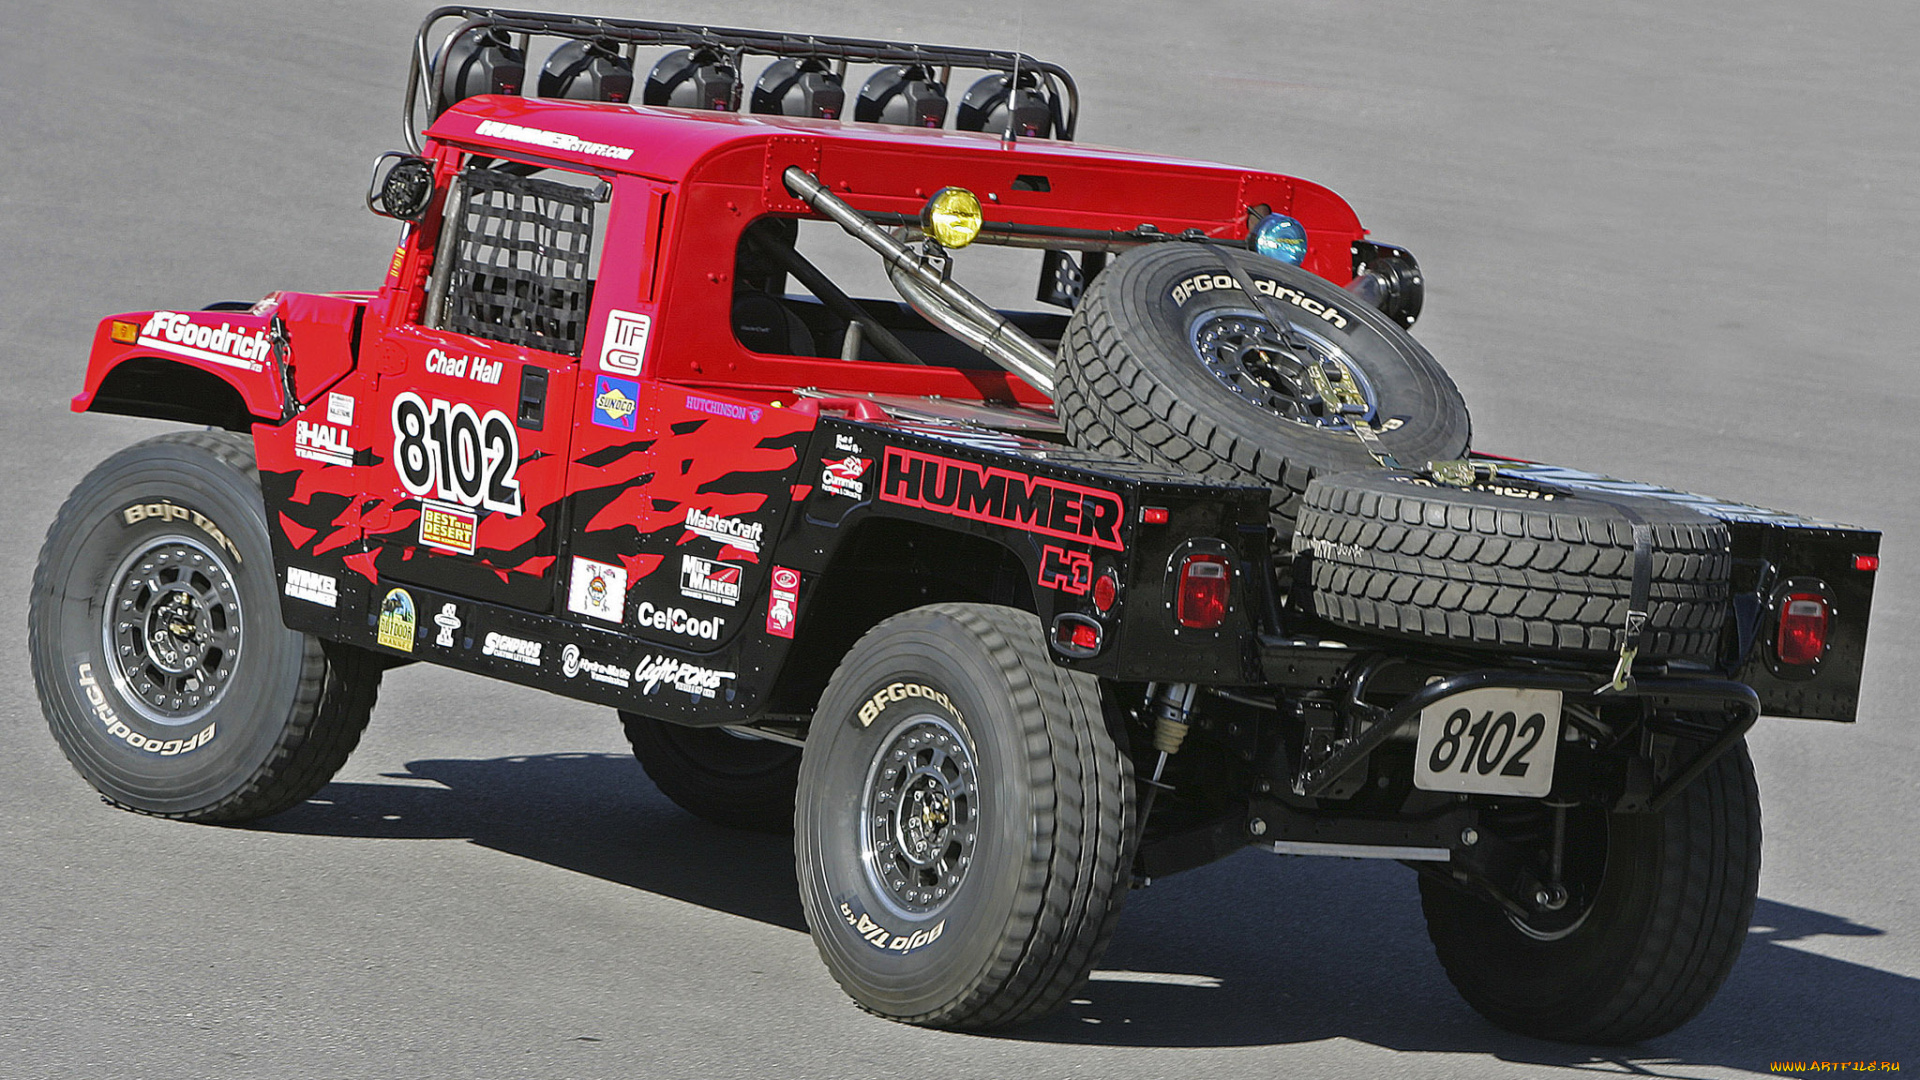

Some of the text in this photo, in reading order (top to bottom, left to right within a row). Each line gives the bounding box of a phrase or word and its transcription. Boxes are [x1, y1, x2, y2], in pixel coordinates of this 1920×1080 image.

[425, 348, 504, 385] Chad Hall
[598, 396, 634, 413] SUNOCO
[685, 395, 747, 421] HUTCHINSON
[304, 420, 354, 456] HALL
[391, 391, 523, 517] 8102
[879, 445, 1125, 552] HUMMER
[424, 522, 472, 543] DESERT
[425, 510, 457, 527] BEST
[682, 554, 712, 575] MILE
[1038, 544, 1093, 596] H1
[688, 572, 738, 598] MARKER
[380, 618, 413, 641] OUTDOOR
[79, 663, 216, 755] BFGoodrich
[1429, 708, 1546, 777] 8102
[856, 913, 891, 949] T/A
[888, 919, 946, 955] Baja
